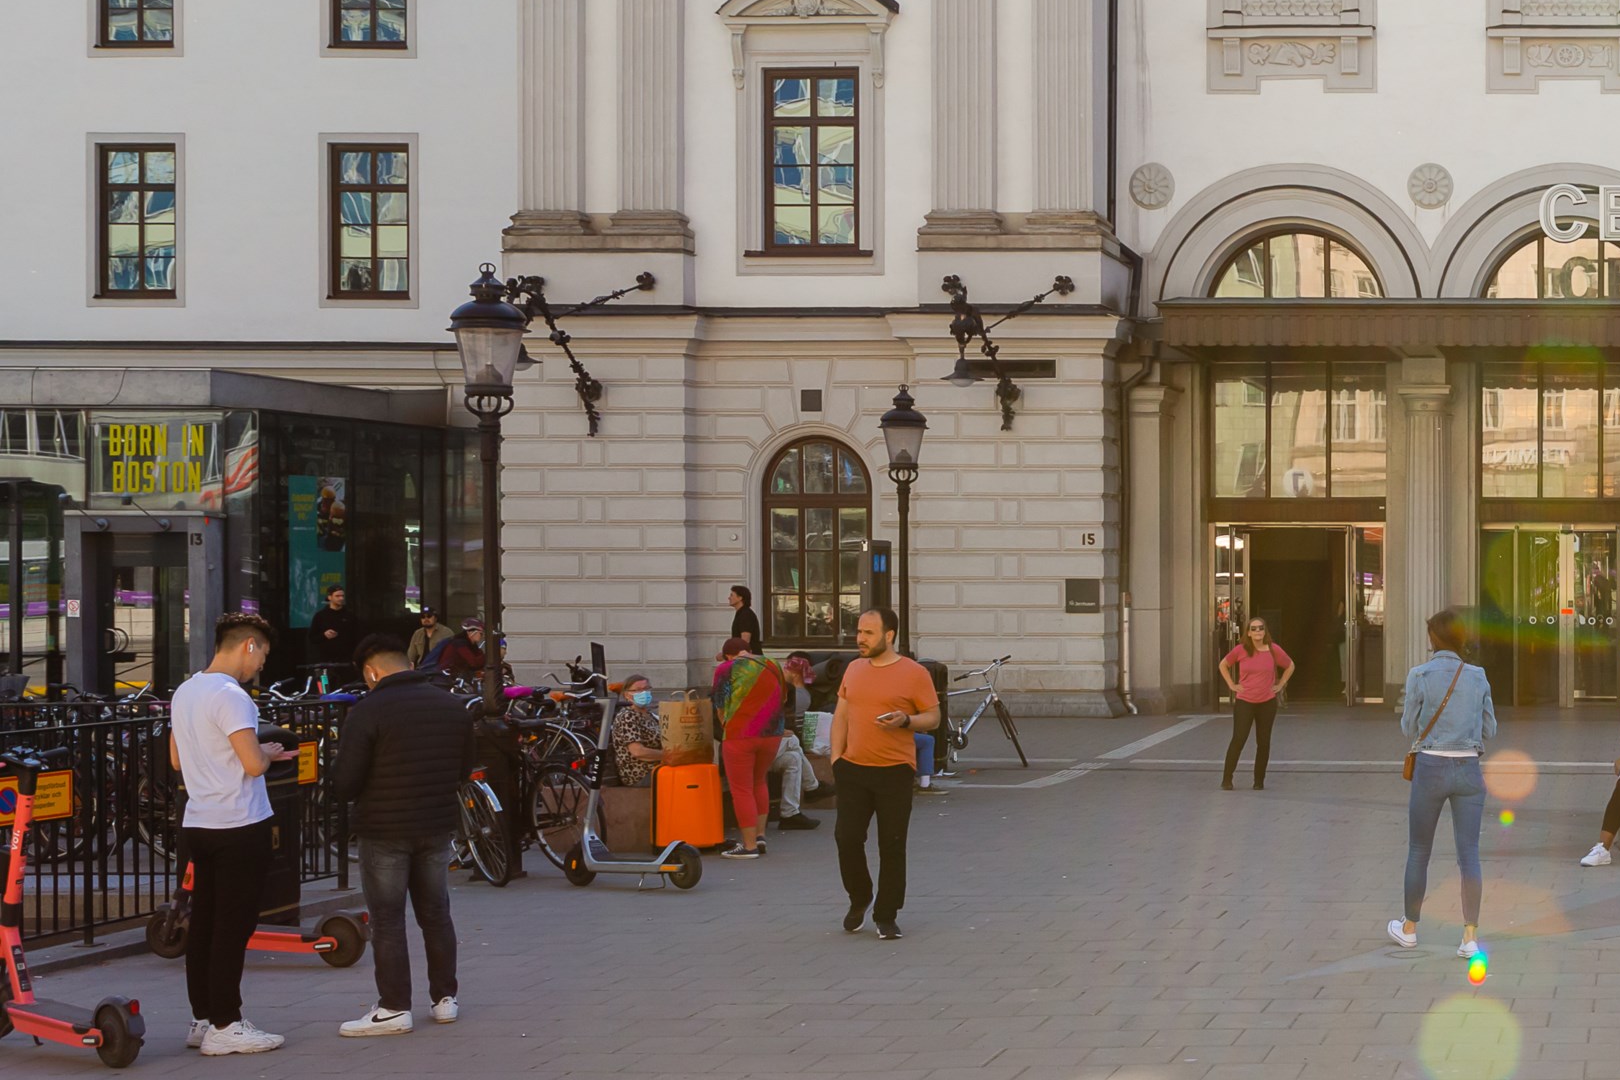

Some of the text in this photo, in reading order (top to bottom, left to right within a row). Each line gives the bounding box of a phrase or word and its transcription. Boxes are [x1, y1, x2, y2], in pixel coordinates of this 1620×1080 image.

[109, 424, 204, 457] BORN IN
[112, 461, 201, 493] BOSTON
[190, 532, 203, 546] 13
[1081, 533, 1096, 546] 15
[591, 755, 600, 782] BIRD
